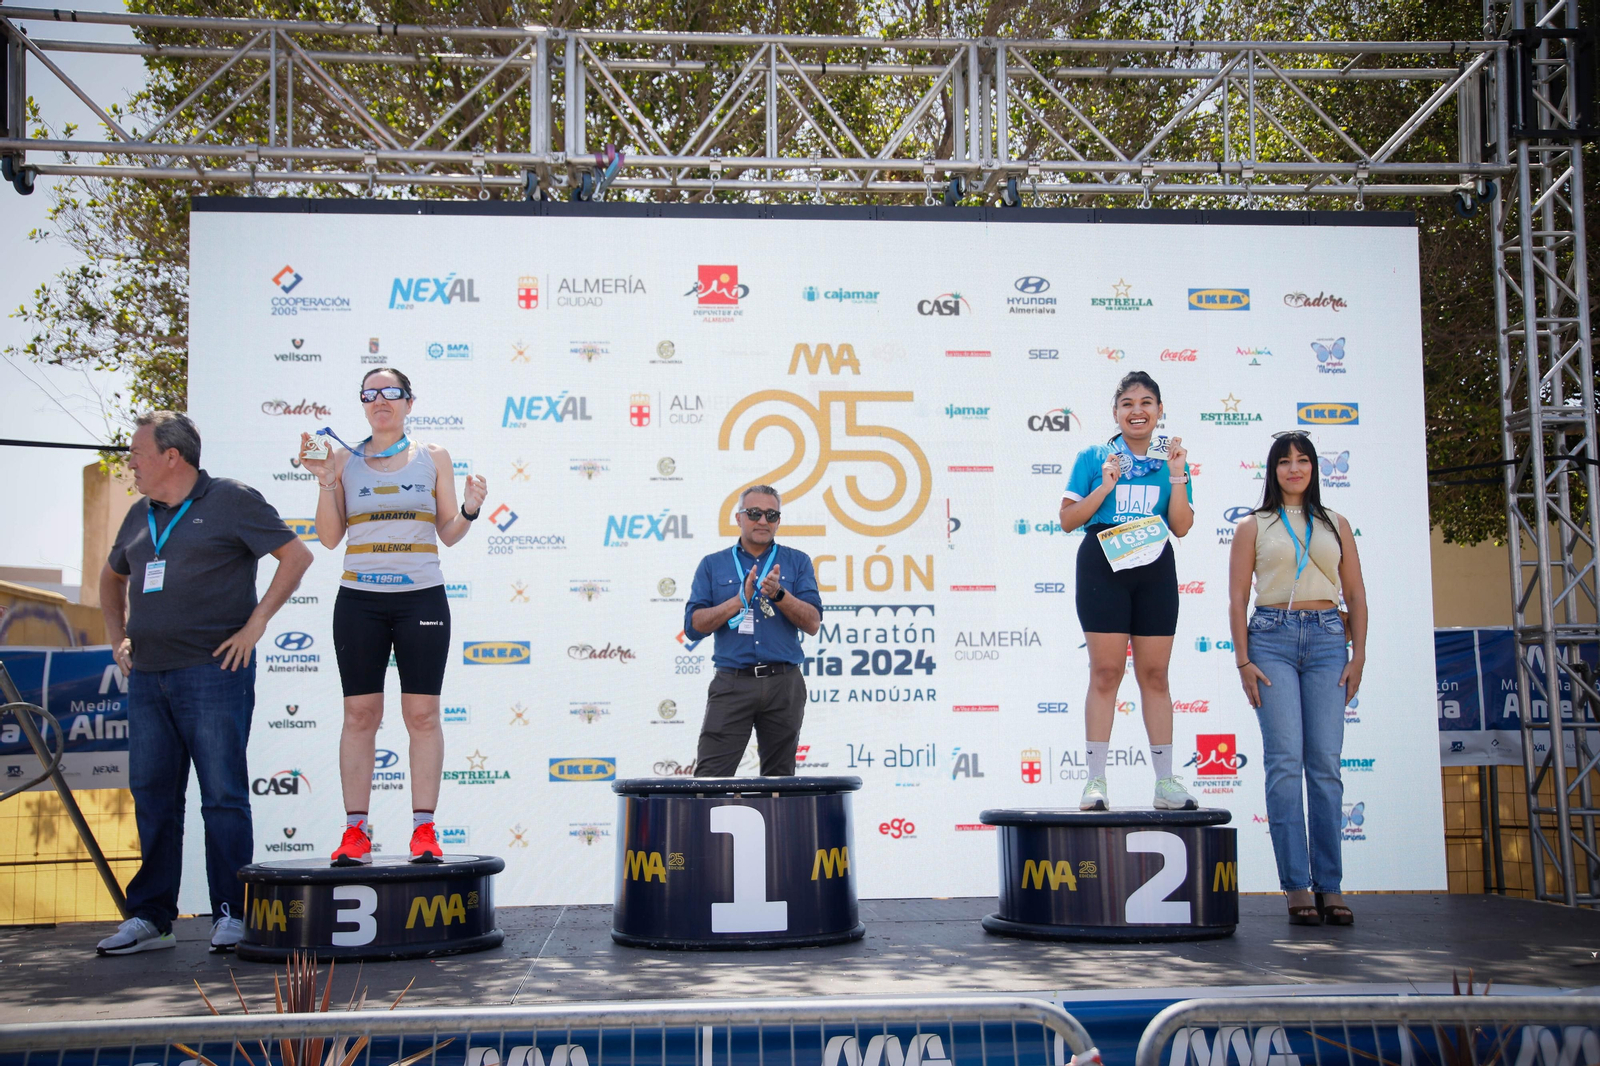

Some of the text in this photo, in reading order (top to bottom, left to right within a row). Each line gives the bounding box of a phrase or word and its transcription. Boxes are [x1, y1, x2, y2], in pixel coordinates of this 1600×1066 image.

[557, 275, 647, 294] ALMERÍA
[824, 287, 880, 302] cajamar
[1196, 294, 1244, 305] IKEA
[271, 297, 350, 306] COOPERACIÓN
[557, 297, 603, 307] CIUDAD
[1007, 297, 1057, 305] HYUNDAI
[1091, 297, 1153, 307] ESTRELLA
[271, 307, 298, 315] 2005
[917, 299, 960, 316] CASI
[1009, 307, 1056, 315] Almerialva
[274, 351, 322, 362] vellsam
[1028, 349, 1059, 359] SER
[669, 414, 703, 424] CIUD
[1200, 412, 1263, 422] ESTRELLA
[1305, 408, 1353, 419] IKEA
[404, 414, 464, 425] OPERACIÓN
[1028, 415, 1070, 431] CASI
[718, 389, 932, 537] 25
[1031, 464, 1062, 475] SER
[1117, 500, 1152, 515] UAL
[370, 511, 416, 521] MARATÓN
[488, 534, 565, 544] COOPERACIÓN
[1109, 524, 1161, 549] 1689
[372, 543, 412, 552] VALENCIA
[488, 546, 514, 555] 2005
[814, 545, 935, 592] CIÓN
[360, 574, 403, 583] 42.195m
[1034, 582, 1065, 593] SER
[286, 595, 319, 604] lsam
[819, 622, 936, 645] Maratón
[955, 627, 1042, 647] ALMERÍA
[472, 648, 524, 658] IKEA
[955, 650, 1000, 661] CIUDAD
[266, 654, 320, 664] HYUNDAI
[851, 648, 937, 676] 2024
[267, 664, 319, 673] Almerialva
[675, 665, 701, 675] 2005
[809, 685, 937, 703] UIZ ANDÚJAR
[70, 699, 121, 712] Medio
[1037, 702, 1068, 713] SER
[268, 718, 316, 729] vellsam
[846, 743, 876, 768] 14
[883, 743, 936, 768] abril
[1060, 748, 1147, 767] ALERÍA
[1340, 757, 1376, 767] amar
[442, 770, 511, 780] ESTRELLA
[558, 765, 610, 775] IKEA
[1060, 768, 1088, 780] CIUD
[372, 772, 405, 781] NDAI
[252, 777, 299, 796] CASI
[371, 782, 404, 791] erialva
[879, 818, 916, 839] ego
[265, 841, 314, 852] vellsam
[668, 852, 685, 866] 25
[710, 805, 788, 934] 1
[1079, 860, 1098, 873] 25
[1125, 831, 1191, 924] 2
[467, 891, 479, 904] 25
[289, 900, 305, 914] 25
[331, 884, 378, 947] 3
